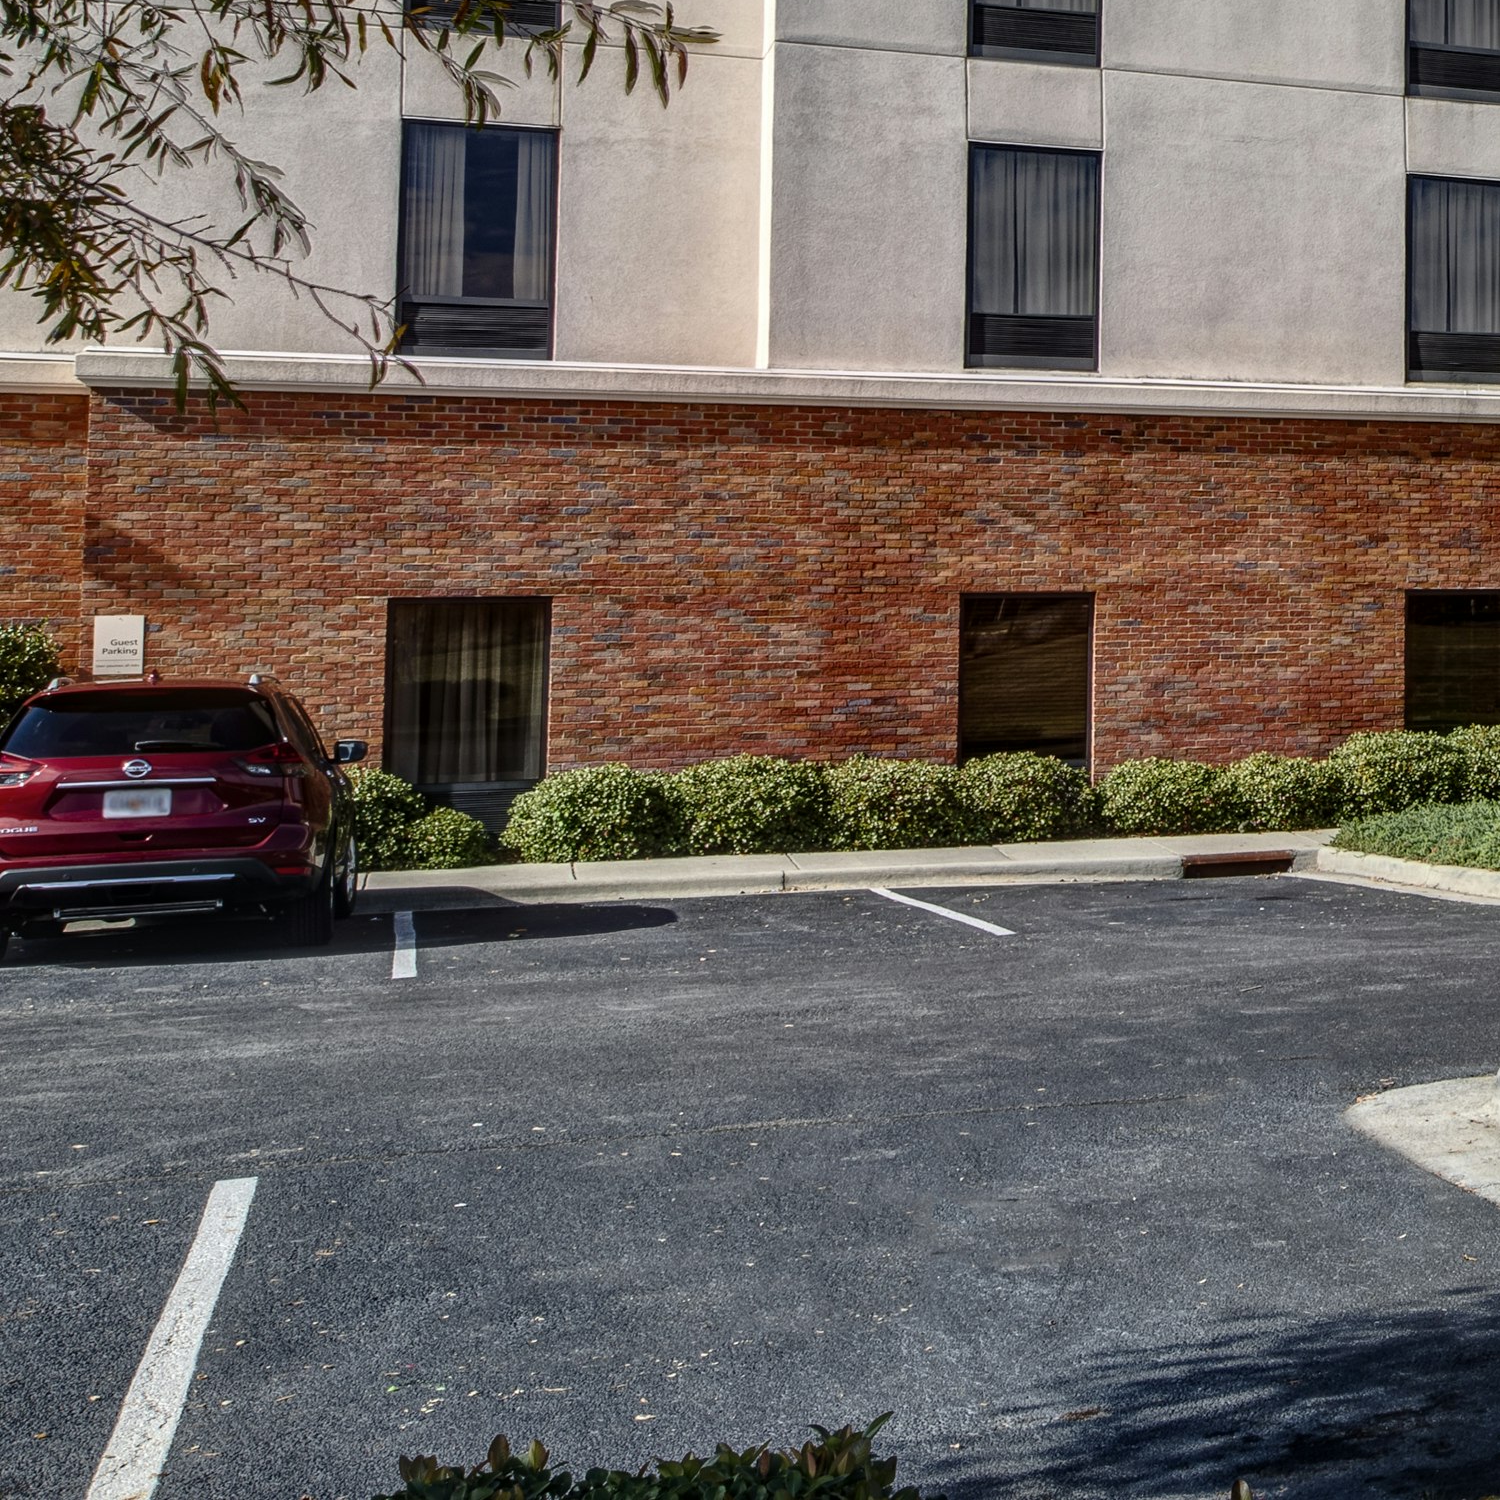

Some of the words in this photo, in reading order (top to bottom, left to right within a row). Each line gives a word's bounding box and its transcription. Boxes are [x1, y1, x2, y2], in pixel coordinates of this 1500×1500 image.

[110, 638, 138, 647] Guest
[102, 647, 138, 656] Parking
[0, 826, 38, 834] OGUE
